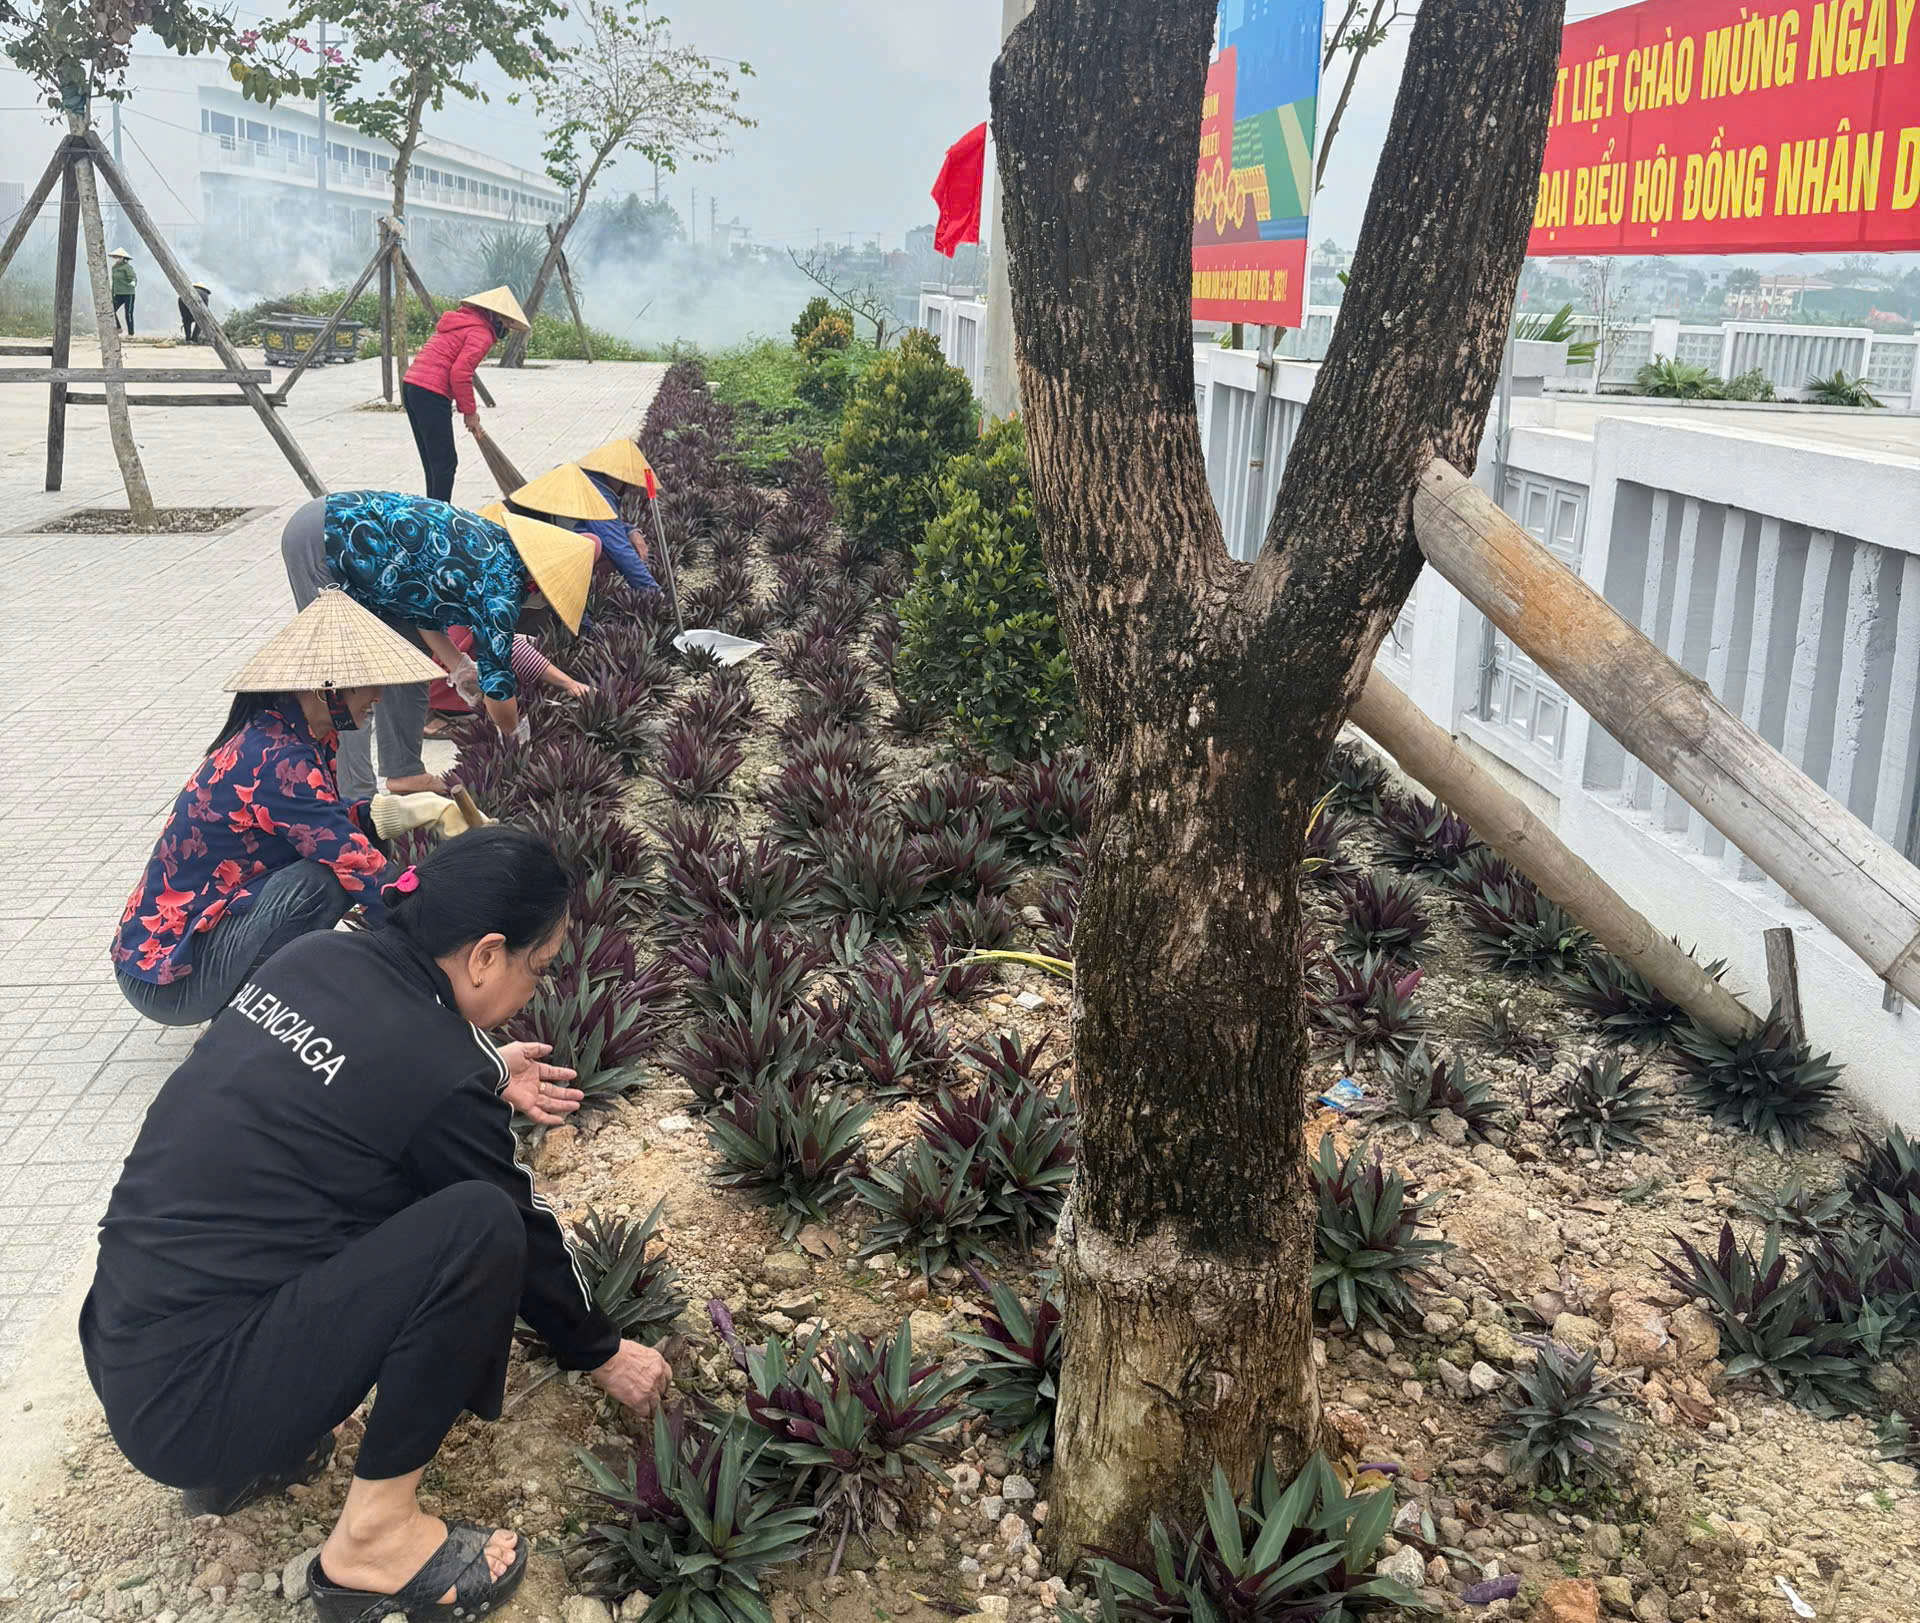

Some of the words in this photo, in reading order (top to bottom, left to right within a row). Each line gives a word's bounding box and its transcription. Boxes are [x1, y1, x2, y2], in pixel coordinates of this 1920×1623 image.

[1571, 45, 1620, 134] LIỆT
[1624, 27, 1695, 114] CHÀO
[1701, 7, 1800, 101] MỪNG
[1534, 169, 1570, 241] ĐẠI
[1573, 137, 1628, 226] BIỂU
[1631, 143, 1678, 238] HỘI
[1682, 126, 1768, 221] ĐỒNG
[1774, 117, 1885, 216] NHÂN
